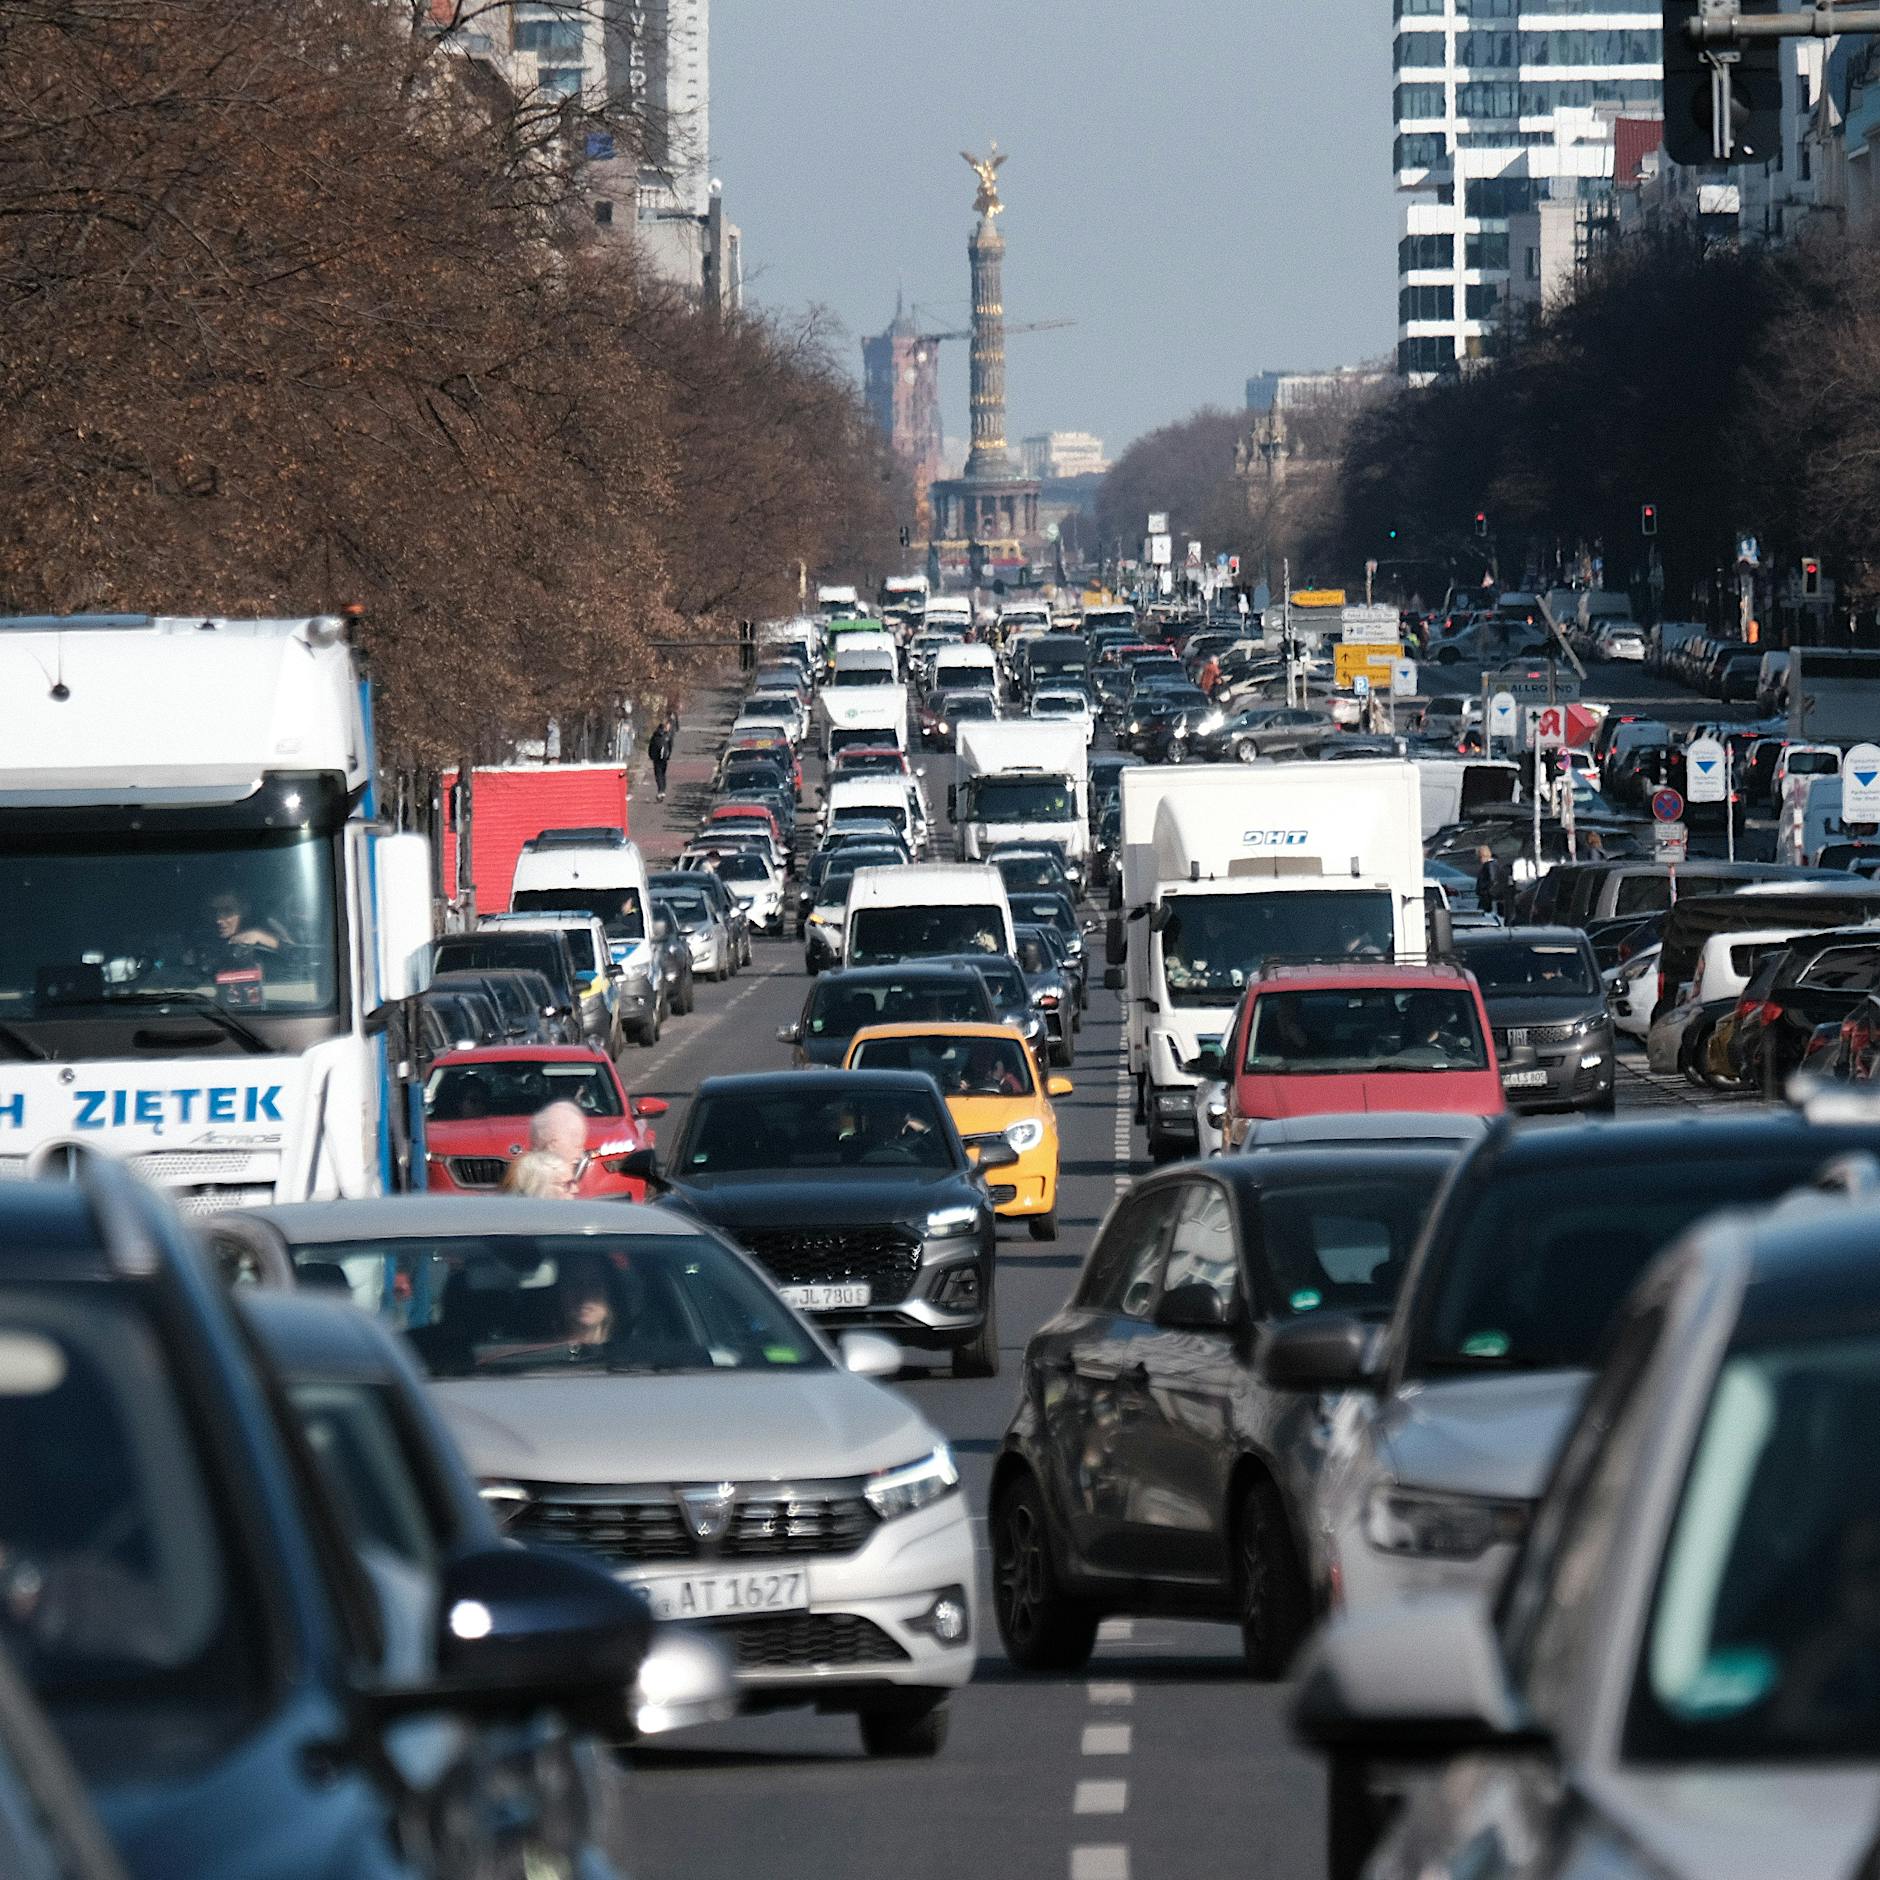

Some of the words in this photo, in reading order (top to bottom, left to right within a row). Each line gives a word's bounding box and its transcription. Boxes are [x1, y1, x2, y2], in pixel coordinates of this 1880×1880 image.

[1510, 684, 1573, 692] ALLROND
[1507, 1028, 1529, 1046] FIAT
[74, 1085, 283, 1136] ZIĘTEK
[680, 1581, 716, 1613] AT
[726, 1573, 800, 1608] 1627
